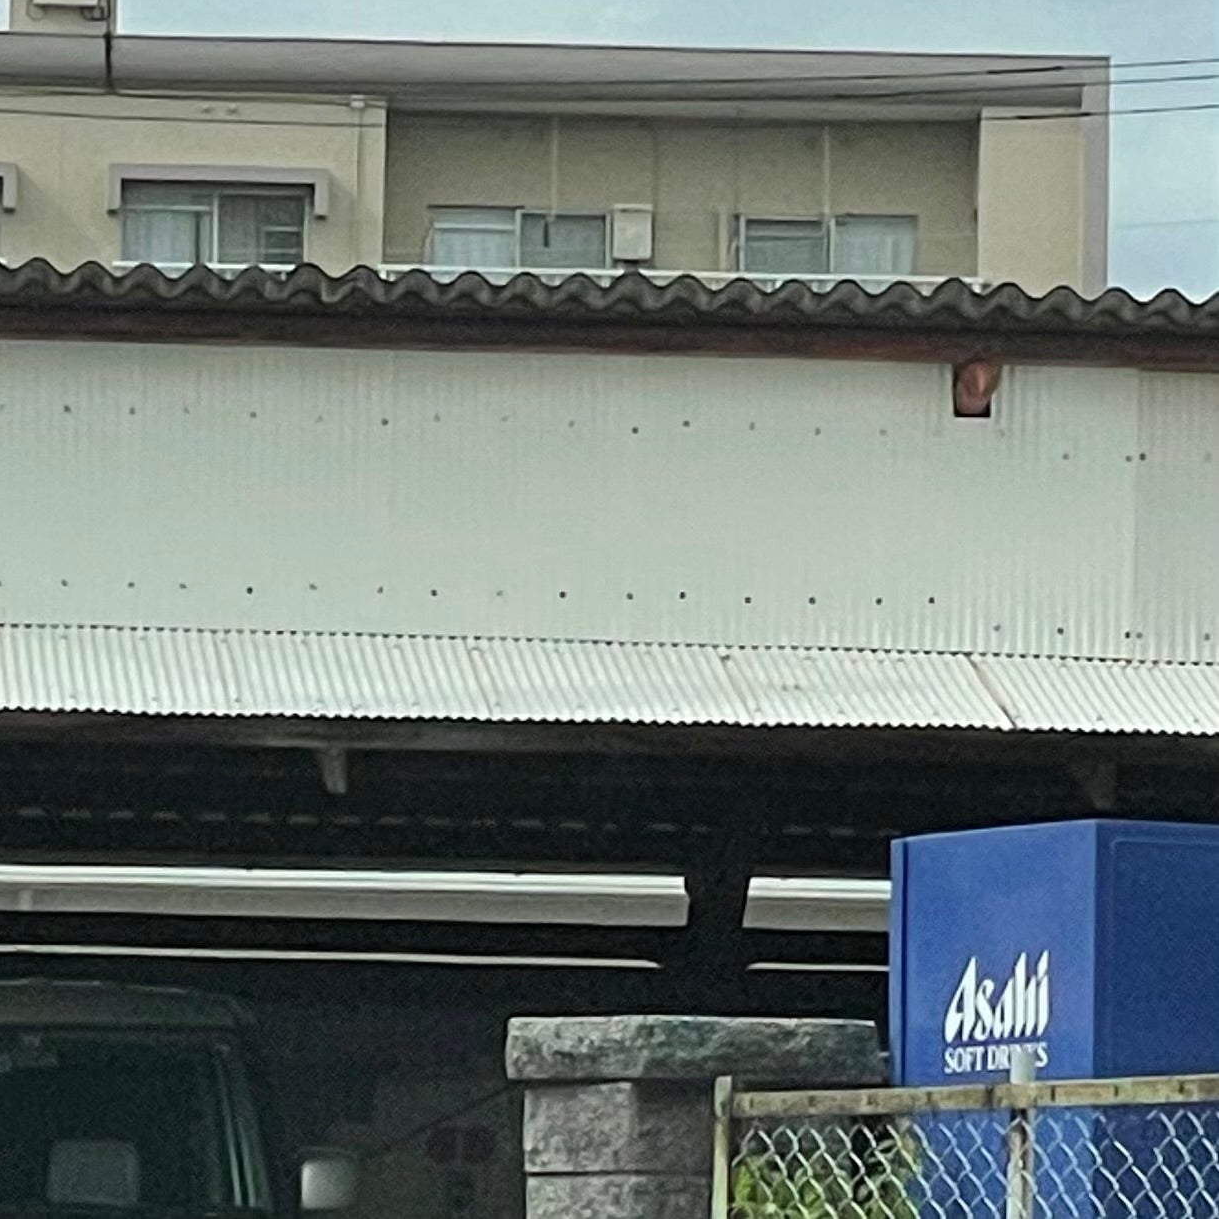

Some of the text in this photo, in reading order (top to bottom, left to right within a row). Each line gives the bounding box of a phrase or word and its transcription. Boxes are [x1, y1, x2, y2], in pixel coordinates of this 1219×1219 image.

[944, 949, 1050, 1044] Asahi
[944, 1041, 1049, 1074] SOFT DRS
